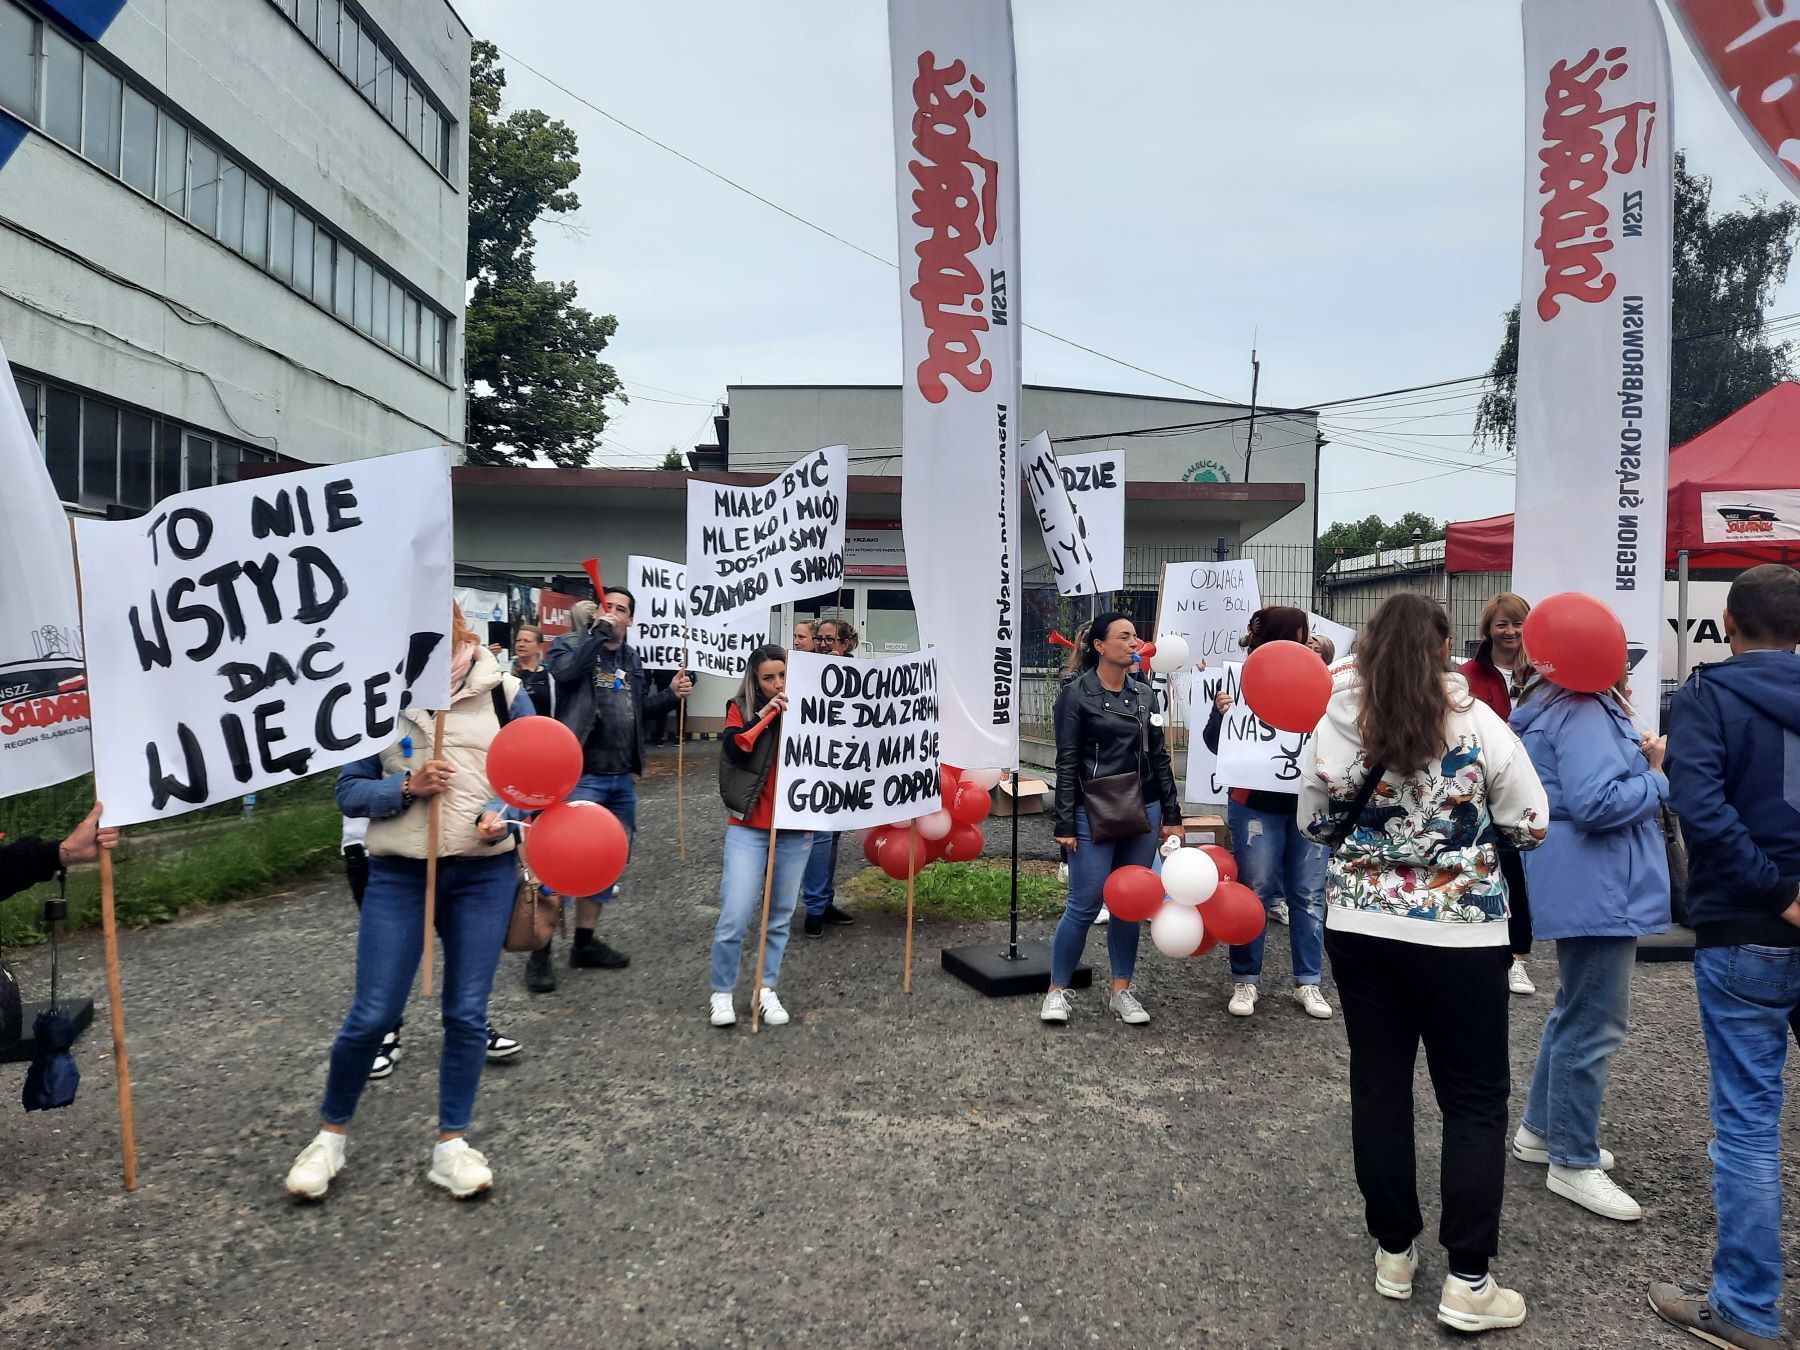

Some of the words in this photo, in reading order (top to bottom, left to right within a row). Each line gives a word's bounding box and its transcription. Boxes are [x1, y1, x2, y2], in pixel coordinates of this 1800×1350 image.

[714, 488, 777, 518] MIAŁO
[782, 451, 829, 499] BYĆ
[147, 507, 214, 566] TO
[251, 478, 363, 540] NIE
[702, 515, 779, 556] MLEKO
[782, 506, 788, 526] I
[795, 489, 840, 526] MIÓD
[641, 565, 673, 590] NIE
[689, 571, 769, 617] SZAMBO
[774, 567, 784, 588] I
[1190, 568, 1245, 591] ODWAGA
[129, 545, 349, 672] WSTYD
[651, 596, 668, 618] W
[1176, 598, 1209, 613] NIE
[1224, 596, 1251, 613] BOLI
[636, 623, 766, 653] POTRZEBUJEMY
[1667, 618, 1730, 644] YA
[216, 628, 345, 702] DAĆ
[820, 656, 938, 700] ODCHODZIMY
[145, 631, 445, 811] WIĘCE!
[800, 695, 847, 727] NIE
[852, 702, 897, 729] DLA
[4, 735, 39, 751] REGION
[784, 732, 872, 773] NALEŻĄ
[876, 732, 915, 769] NAM
[787, 778, 876, 815] GODNE
